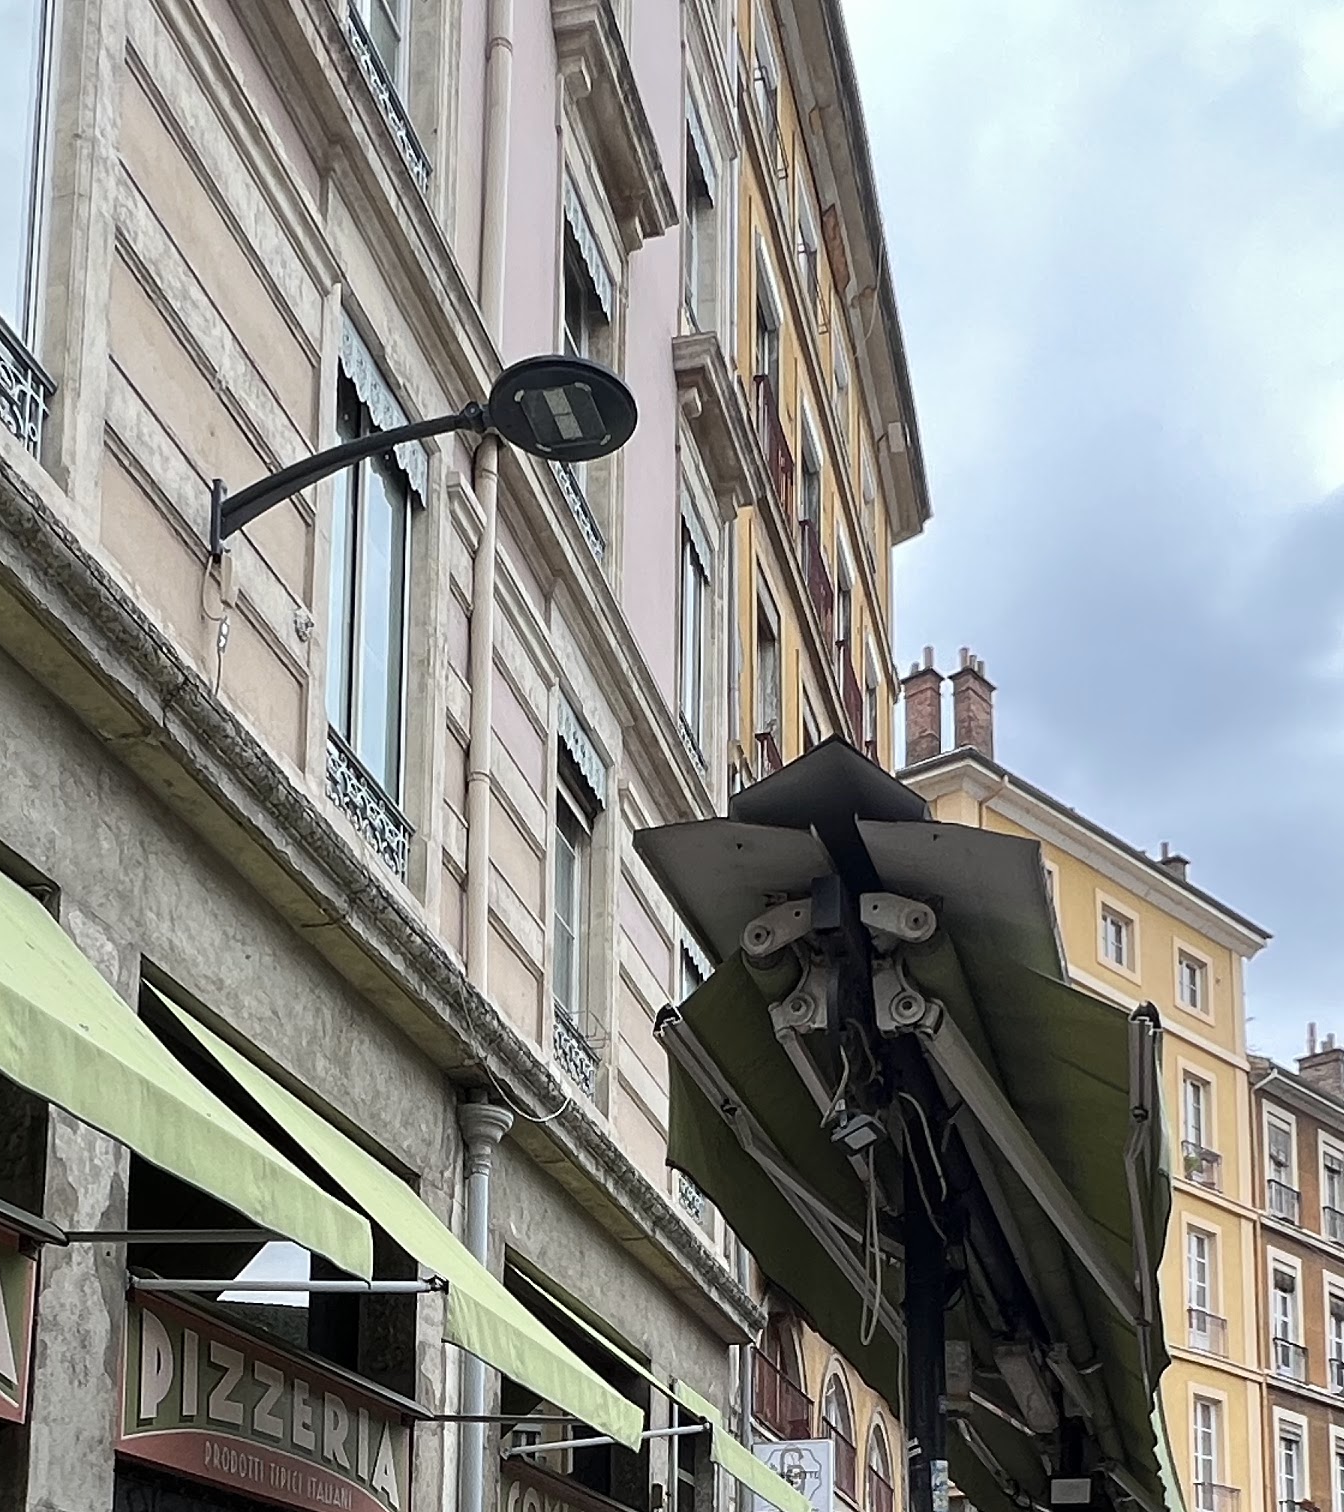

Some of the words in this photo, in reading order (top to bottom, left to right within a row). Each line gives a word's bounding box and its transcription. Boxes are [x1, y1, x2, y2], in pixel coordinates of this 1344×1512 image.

[139, 1308, 400, 1512] PIZZERIA
[204, 1440, 264, 1483] PRODOTTI
[270, 1462, 303, 1495] TIPICI
[307, 1477, 353, 1511] ITALIANI
